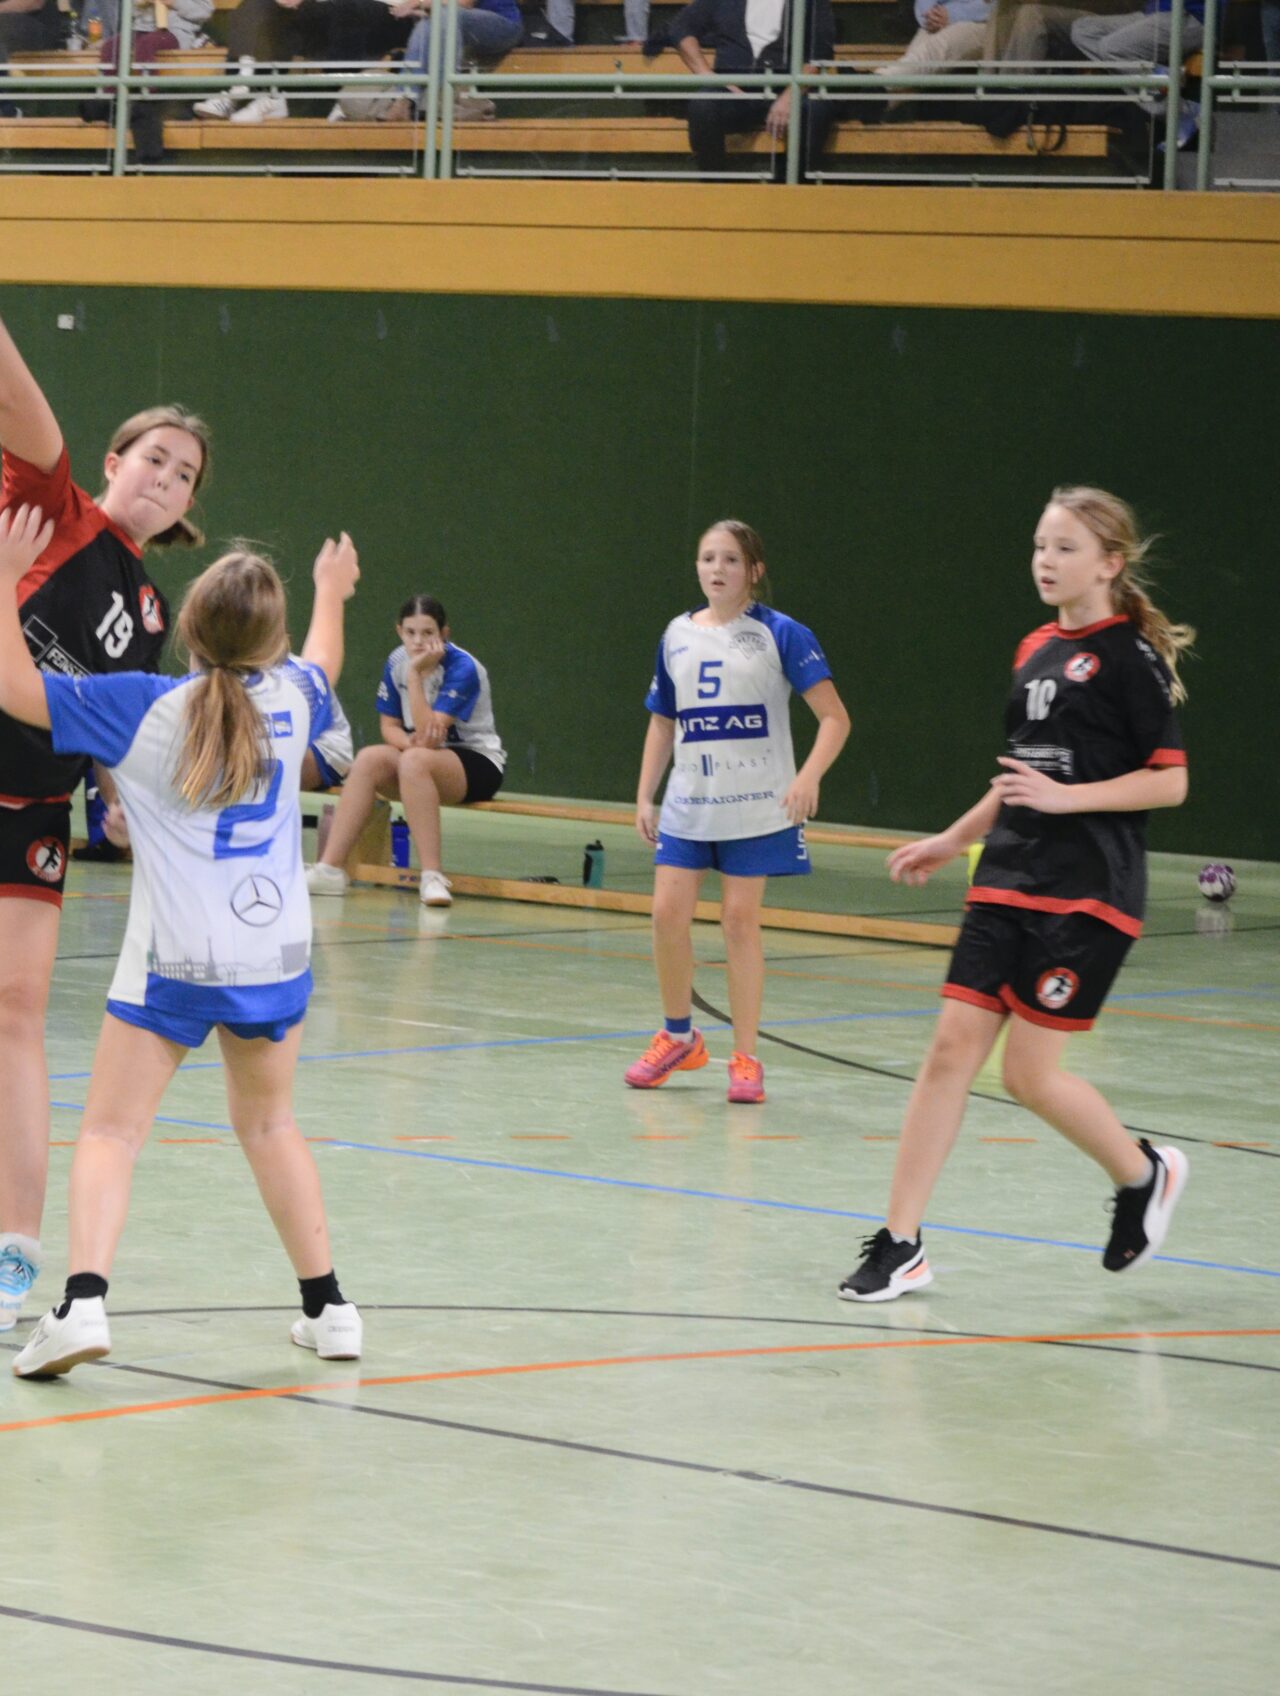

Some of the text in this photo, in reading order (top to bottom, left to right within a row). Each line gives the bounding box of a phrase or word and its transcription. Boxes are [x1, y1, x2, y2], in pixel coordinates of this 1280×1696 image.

[697, 660, 724, 700] 5
[1023, 679, 1058, 721] 10
[724, 715, 764, 731] AG
[213, 758, 284, 861] 2
